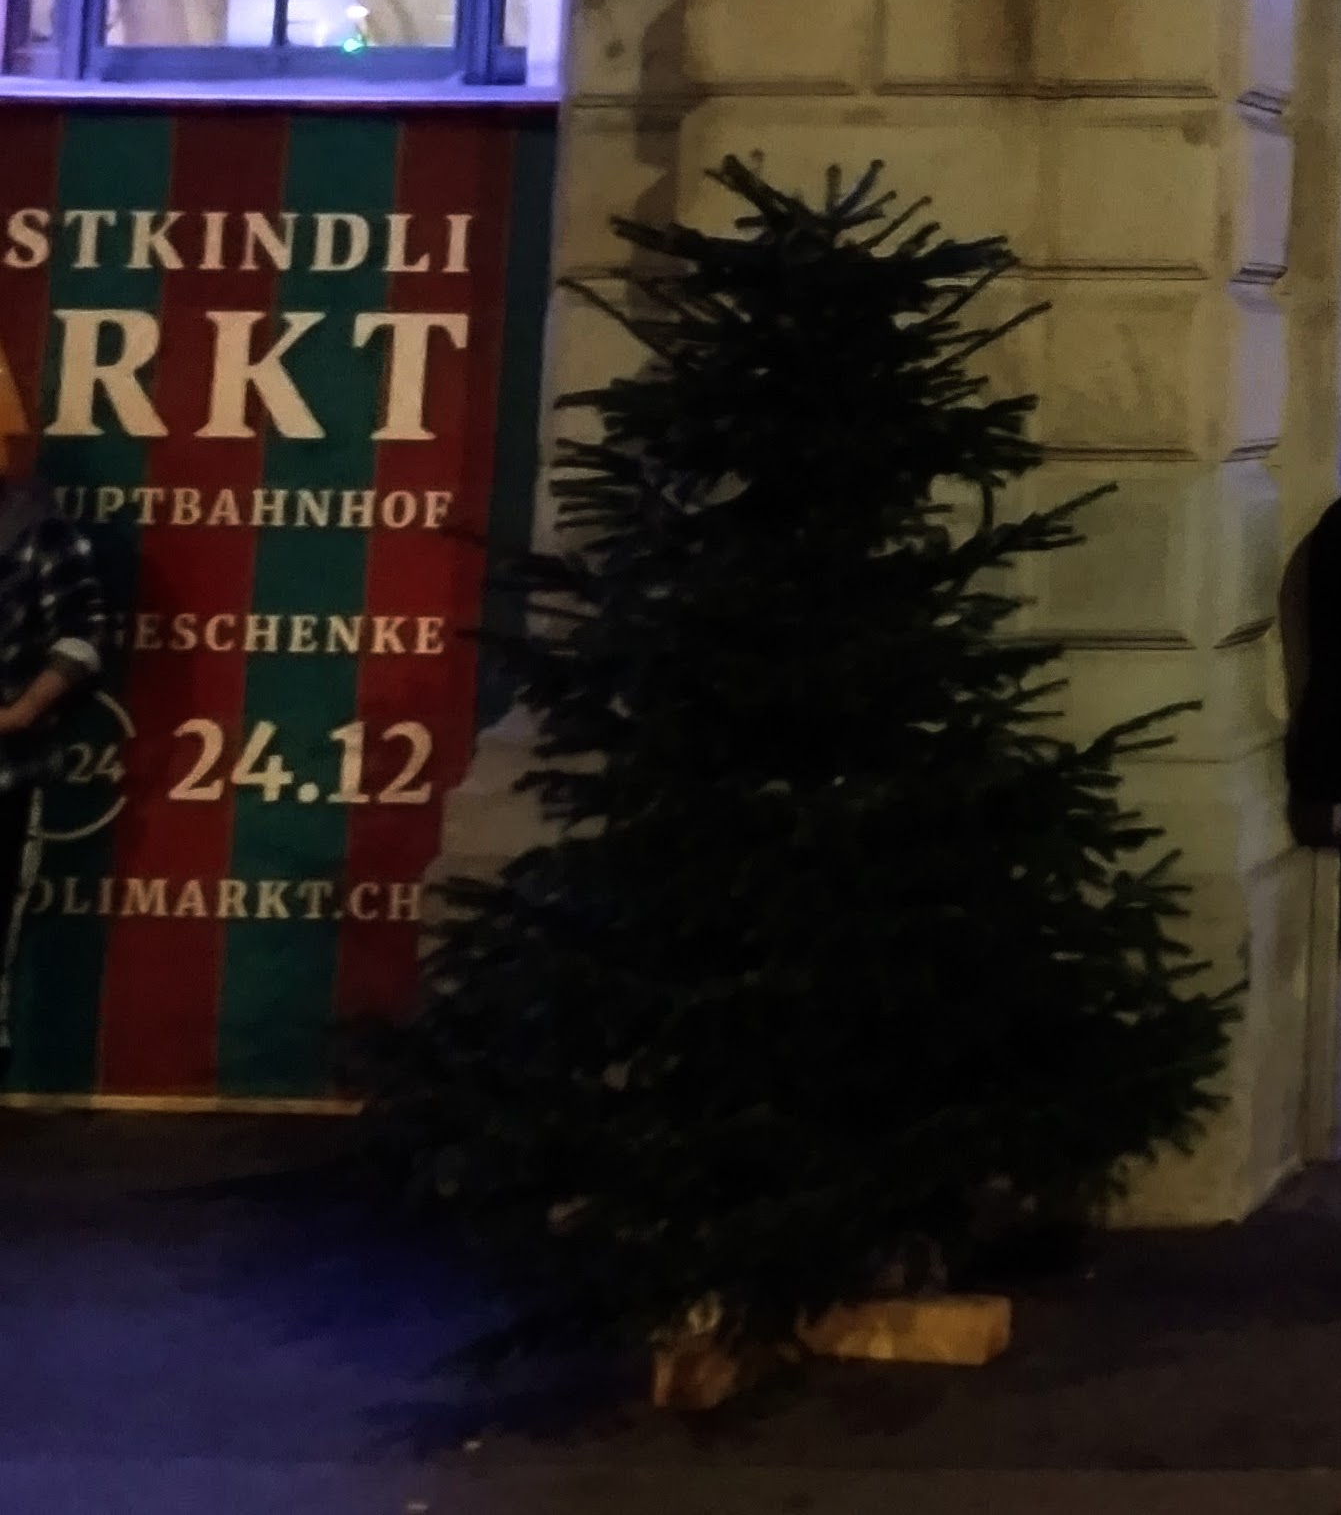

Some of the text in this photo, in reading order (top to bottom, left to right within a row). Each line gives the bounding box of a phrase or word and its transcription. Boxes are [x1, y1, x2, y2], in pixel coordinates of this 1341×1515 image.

[3, 208, 473, 274] STKINDLI
[44, 308, 470, 441] RKT
[167, 717, 433, 805] 24.12
